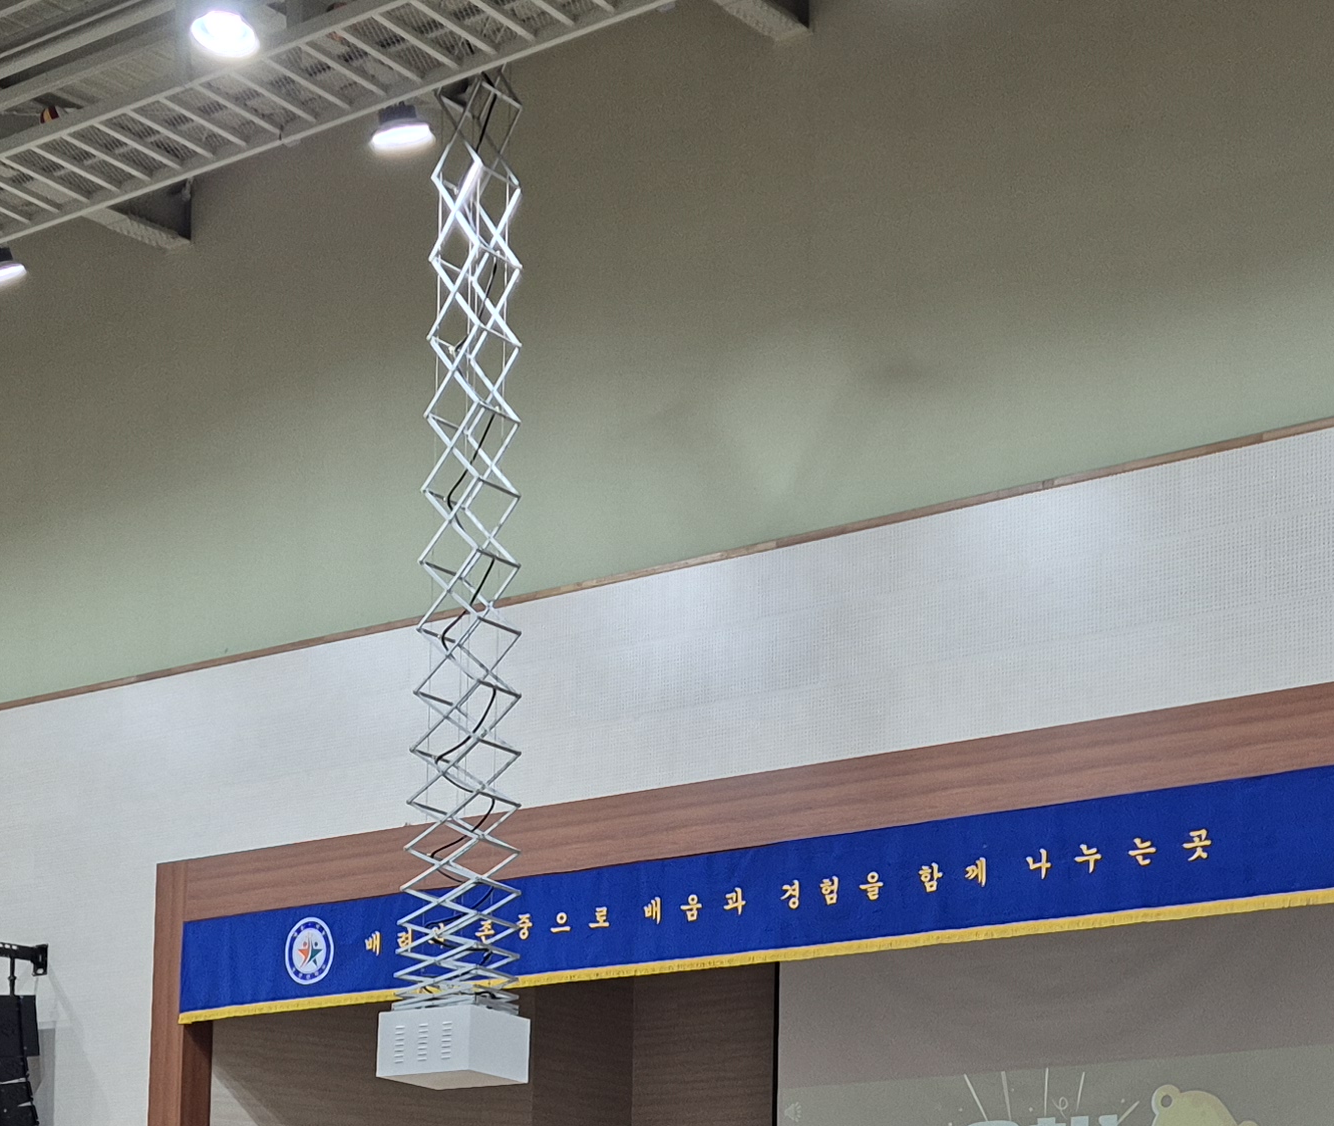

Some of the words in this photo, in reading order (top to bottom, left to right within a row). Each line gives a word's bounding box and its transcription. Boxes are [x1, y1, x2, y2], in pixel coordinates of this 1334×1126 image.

[475, 906, 610, 945] 존중으로
[643, 887, 746, 925] 배움과
[781, 871, 884, 910] 경험을
[918, 857, 987, 893] 함께
[1025, 837, 1157, 880] 나누는
[1182, 828, 1212, 862] 곳
